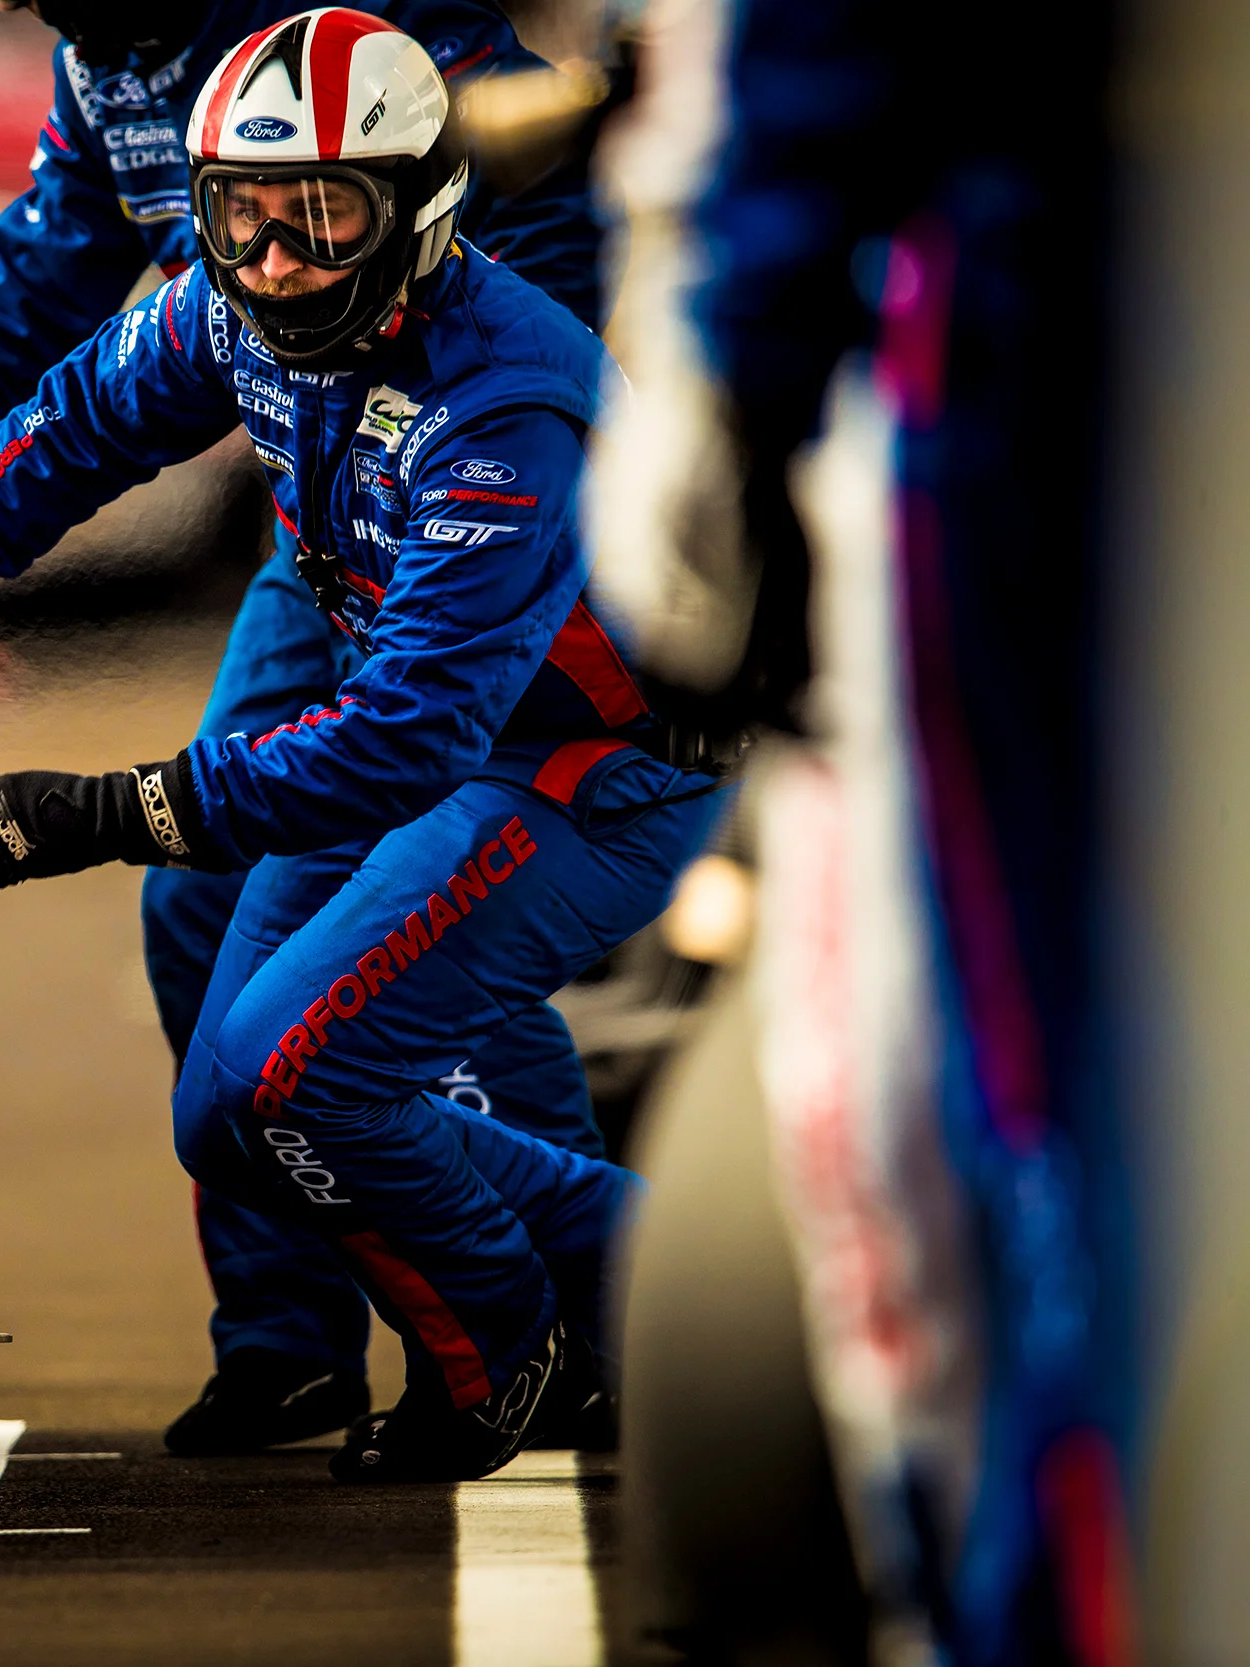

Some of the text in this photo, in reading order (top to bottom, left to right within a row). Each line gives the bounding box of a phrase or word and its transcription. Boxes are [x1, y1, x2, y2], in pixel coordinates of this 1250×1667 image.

[243, 118, 285, 139] Ford
[361, 88, 387, 137] GT
[209, 286, 232, 364] parco
[237, 392, 293, 429] EDGE
[251, 378, 294, 409] Castrol
[399, 406, 449, 487] sparco
[462, 461, 504, 482] Ford
[422, 489, 448, 503] FORD
[447, 489, 539, 508] PERFORMANCE
[353, 518, 386, 549] IHG
[424, 519, 520, 546] GT
[141, 770, 187, 856] sparco
[253, 815, 538, 1121] PERFORMANCE
[264, 1126, 352, 1205] FORD
